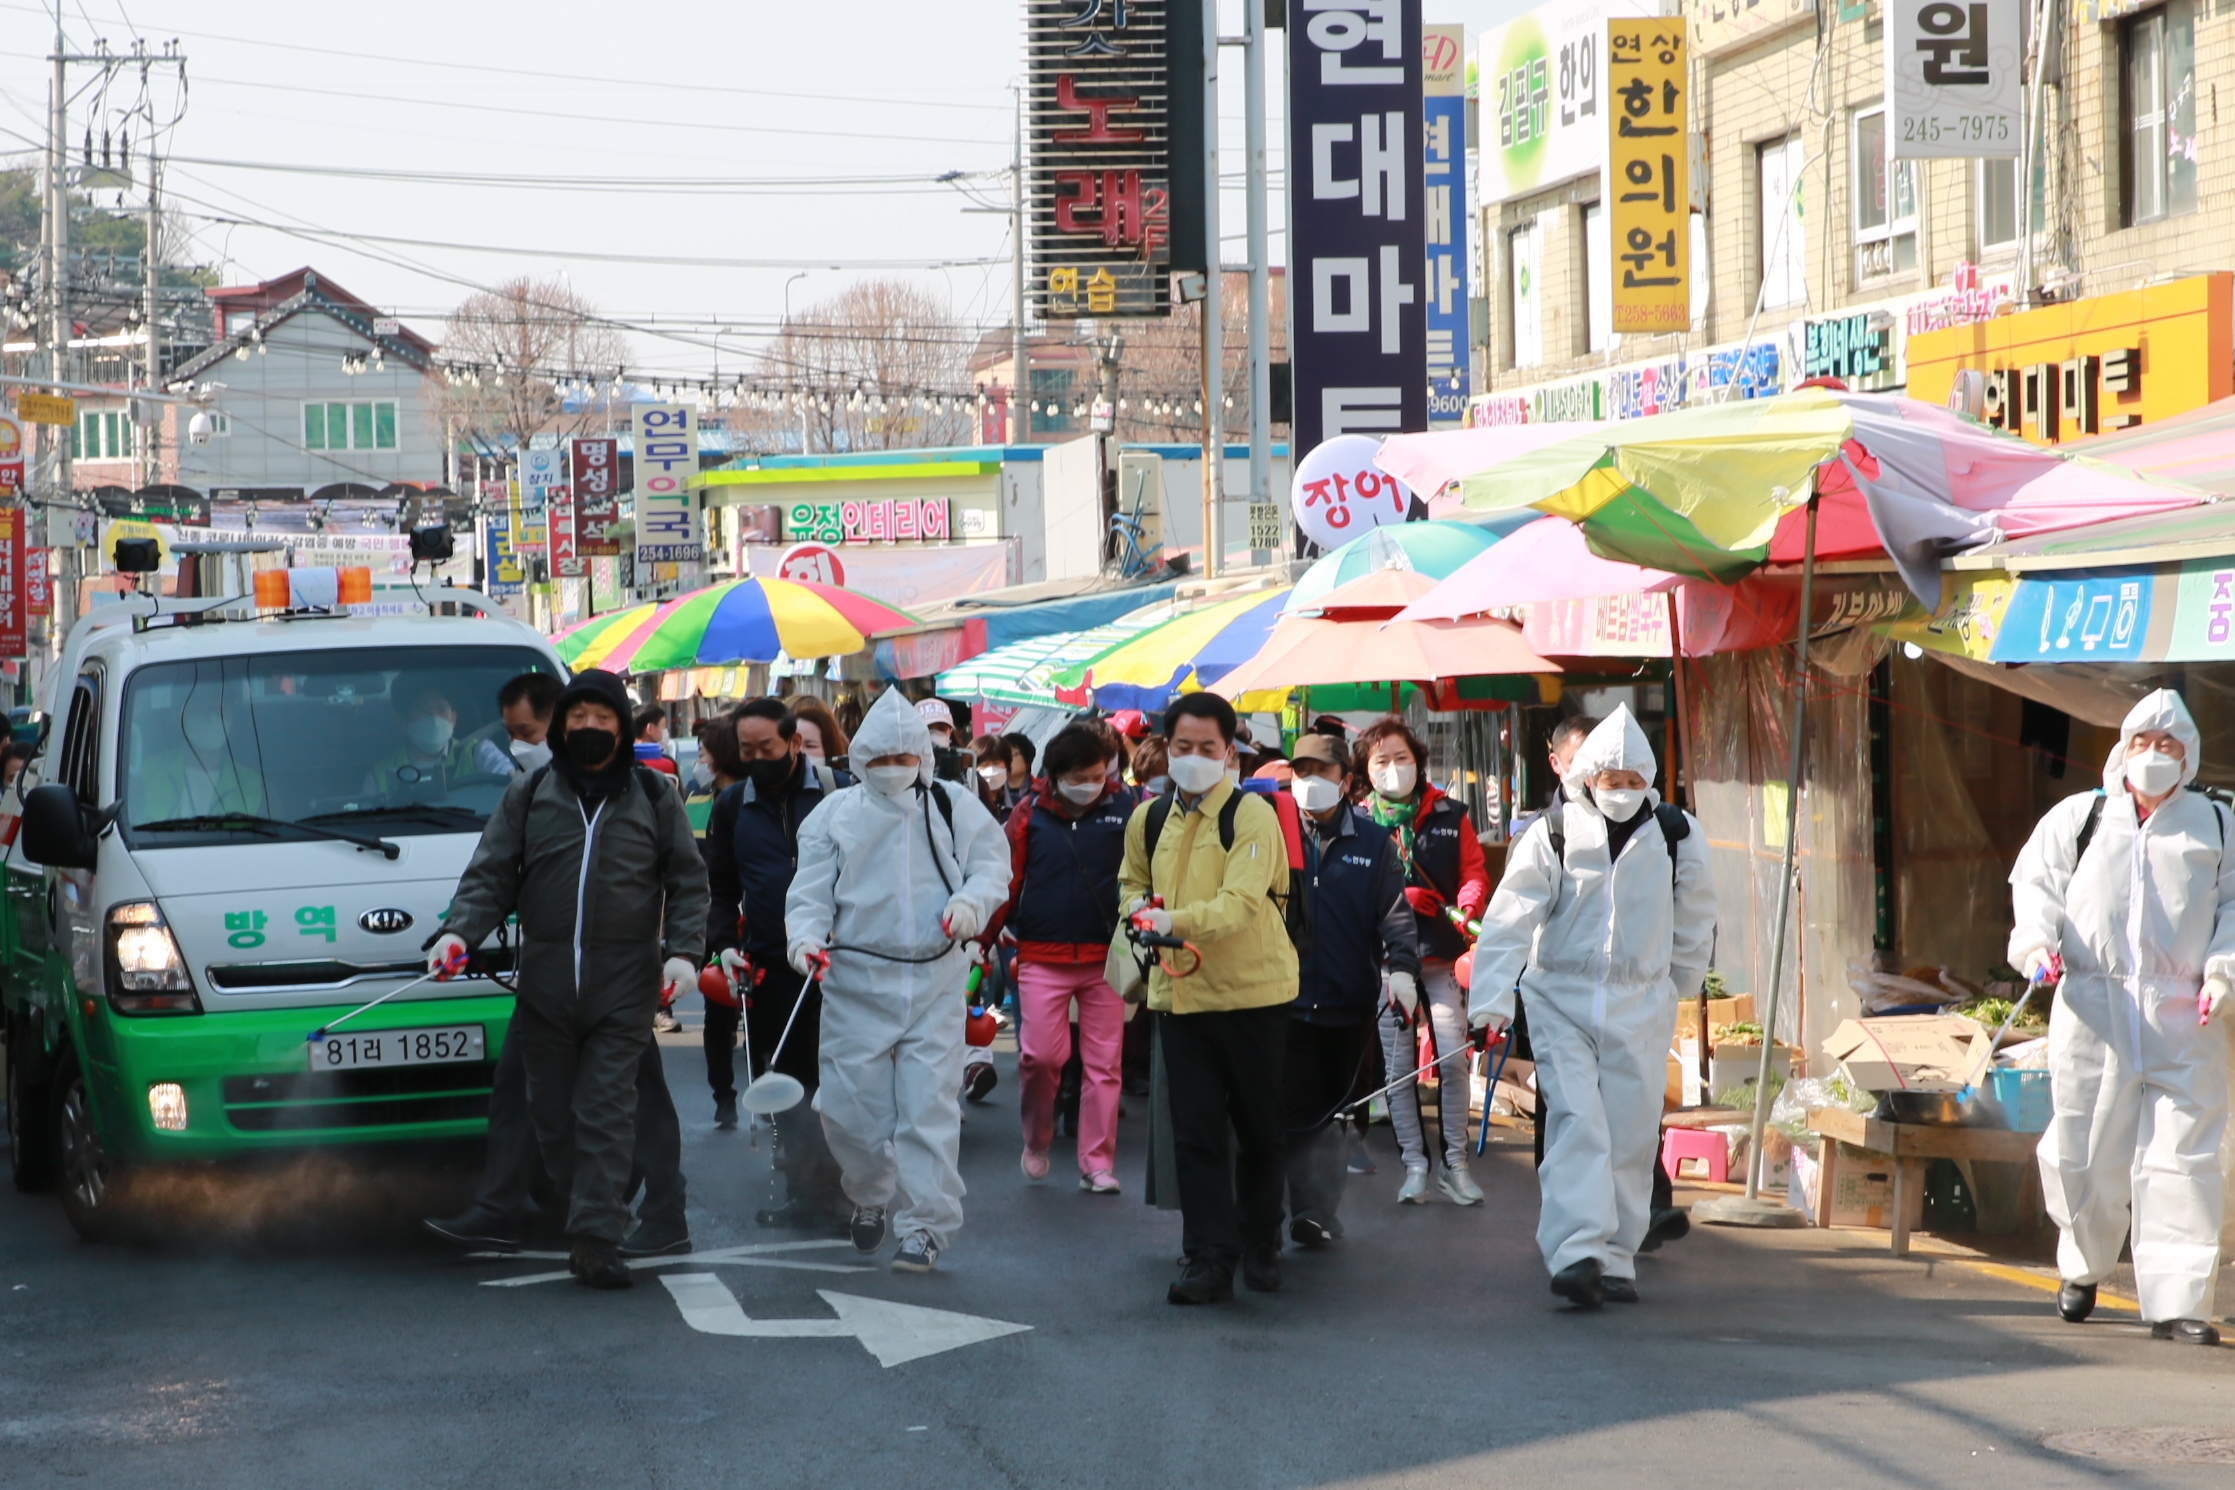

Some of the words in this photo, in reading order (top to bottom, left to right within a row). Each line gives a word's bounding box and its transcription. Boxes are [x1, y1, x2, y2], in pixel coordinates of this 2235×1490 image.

[1612, 34, 1682, 65] 연상
[1916, 3, 1989, 86] 원
[1903, 114, 2009, 142] 245-7975
[1053, 73, 1145, 247] 노래
[1616, 78, 1682, 289] 한의원
[1050, 267, 1116, 313] 연습
[1303, 470, 1404, 528] 장어
[1250, 525, 1279, 535] 1522
[1250, 537, 1279, 548] 4780
[326, 1038, 382, 1066] 81러
[398, 1031, 469, 1061] 1852
